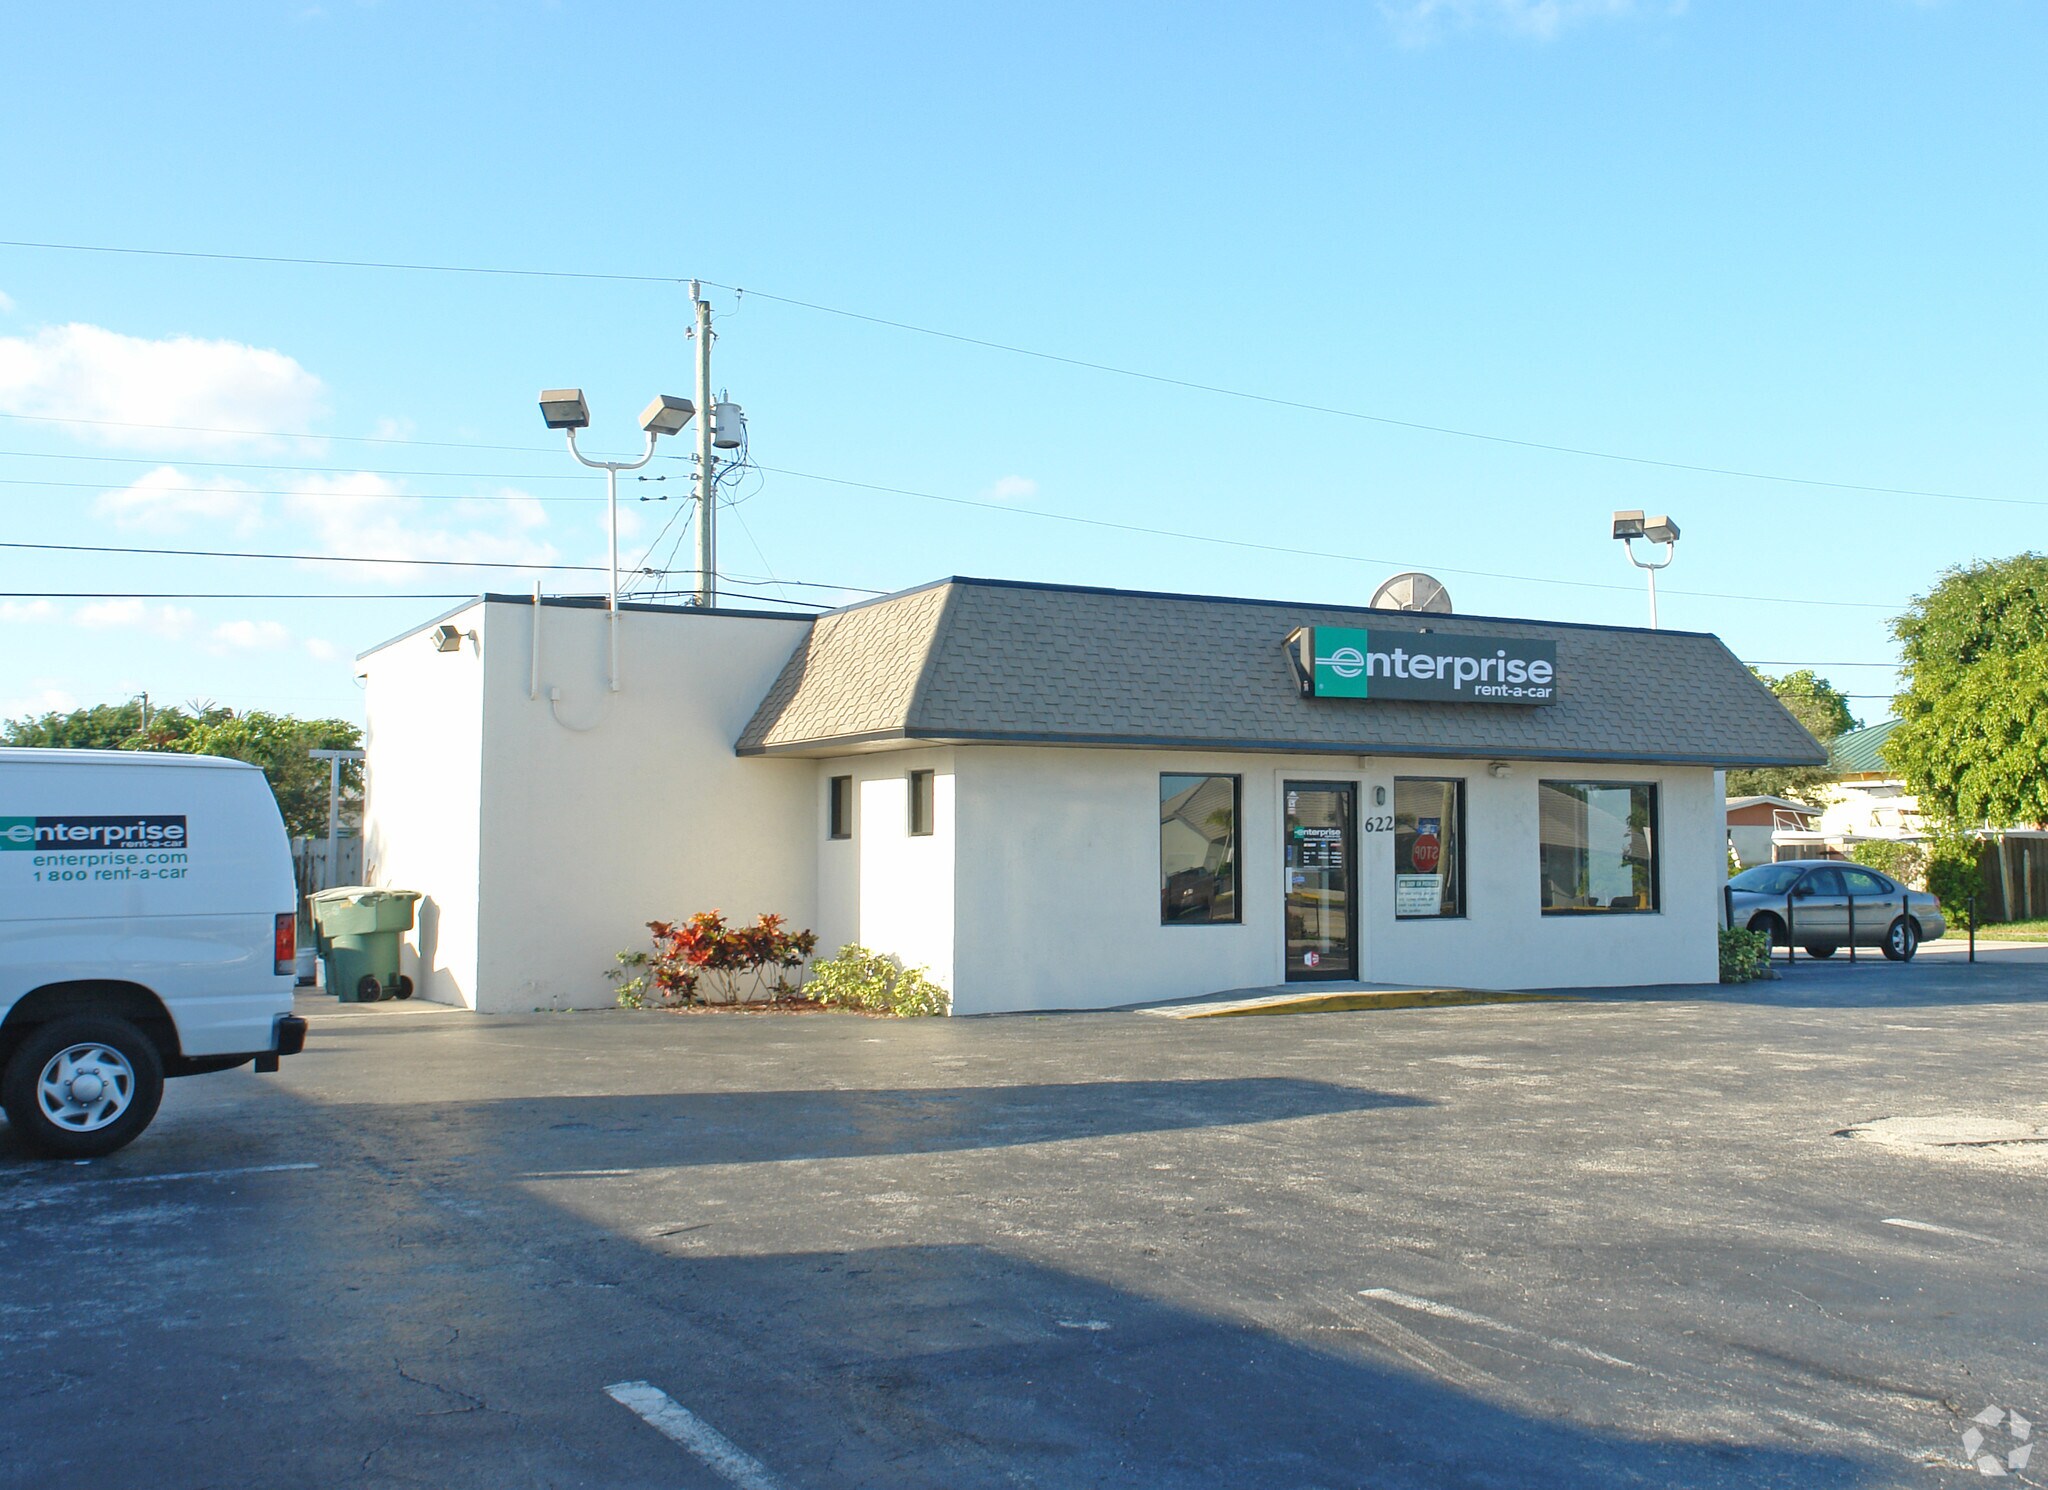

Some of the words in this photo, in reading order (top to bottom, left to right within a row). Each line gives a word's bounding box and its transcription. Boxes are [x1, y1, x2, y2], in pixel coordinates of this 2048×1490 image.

[1316, 647, 1553, 690] enterprise
[1474, 684, 1553, 699] rent-a-car
[6, 820, 184, 845] enterprise
[1296, 828, 1341, 837] enterprise
[1365, 816, 1394, 833] 622
[120, 839, 185, 849] rent-a-car
[33, 851, 188, 868] enterprise.com
[34, 871, 41, 882] 1
[47, 869, 88, 882] 800
[94, 867, 188, 881] rent-a-car
